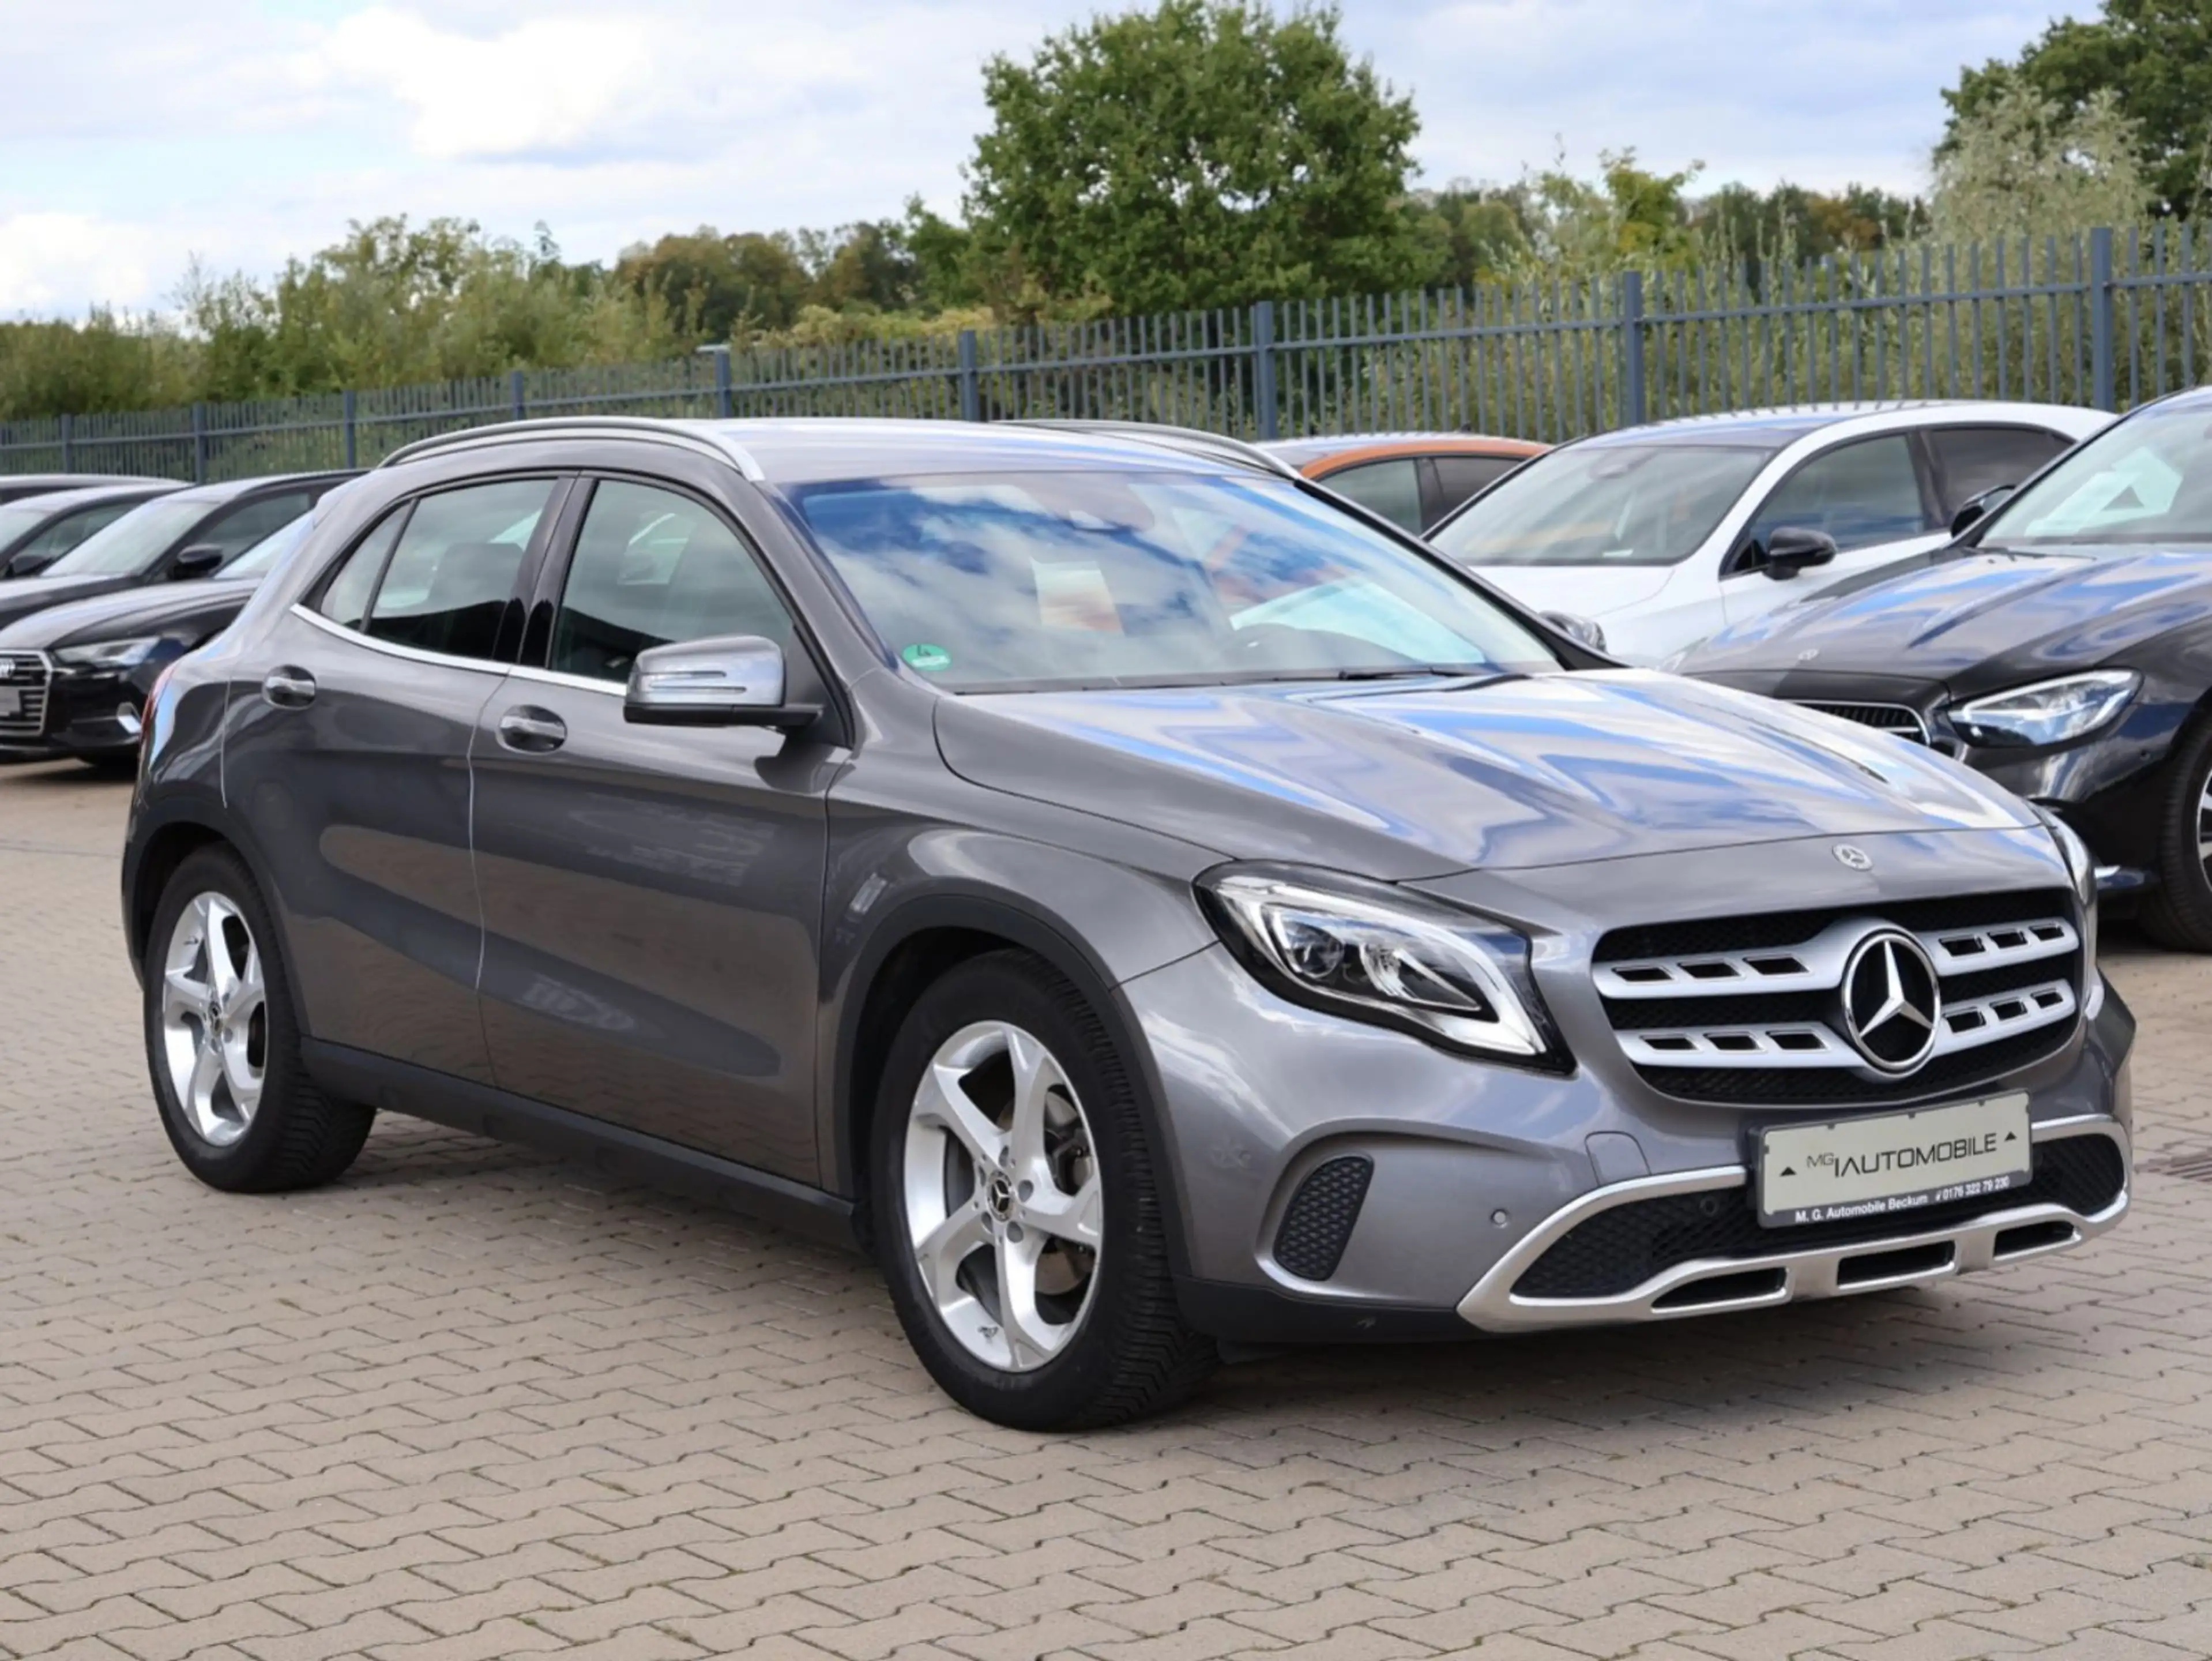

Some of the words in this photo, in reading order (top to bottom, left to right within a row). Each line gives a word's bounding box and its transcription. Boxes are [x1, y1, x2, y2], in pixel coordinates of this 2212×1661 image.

[1807, 1153, 1834, 1168] MG
[1795, 1210, 1809, 1223] M.
[1812, 1209, 1823, 1221] G.
[1826, 1202, 1885, 1219] Automobile
[1888, 1195, 1928, 1210] Beckum
